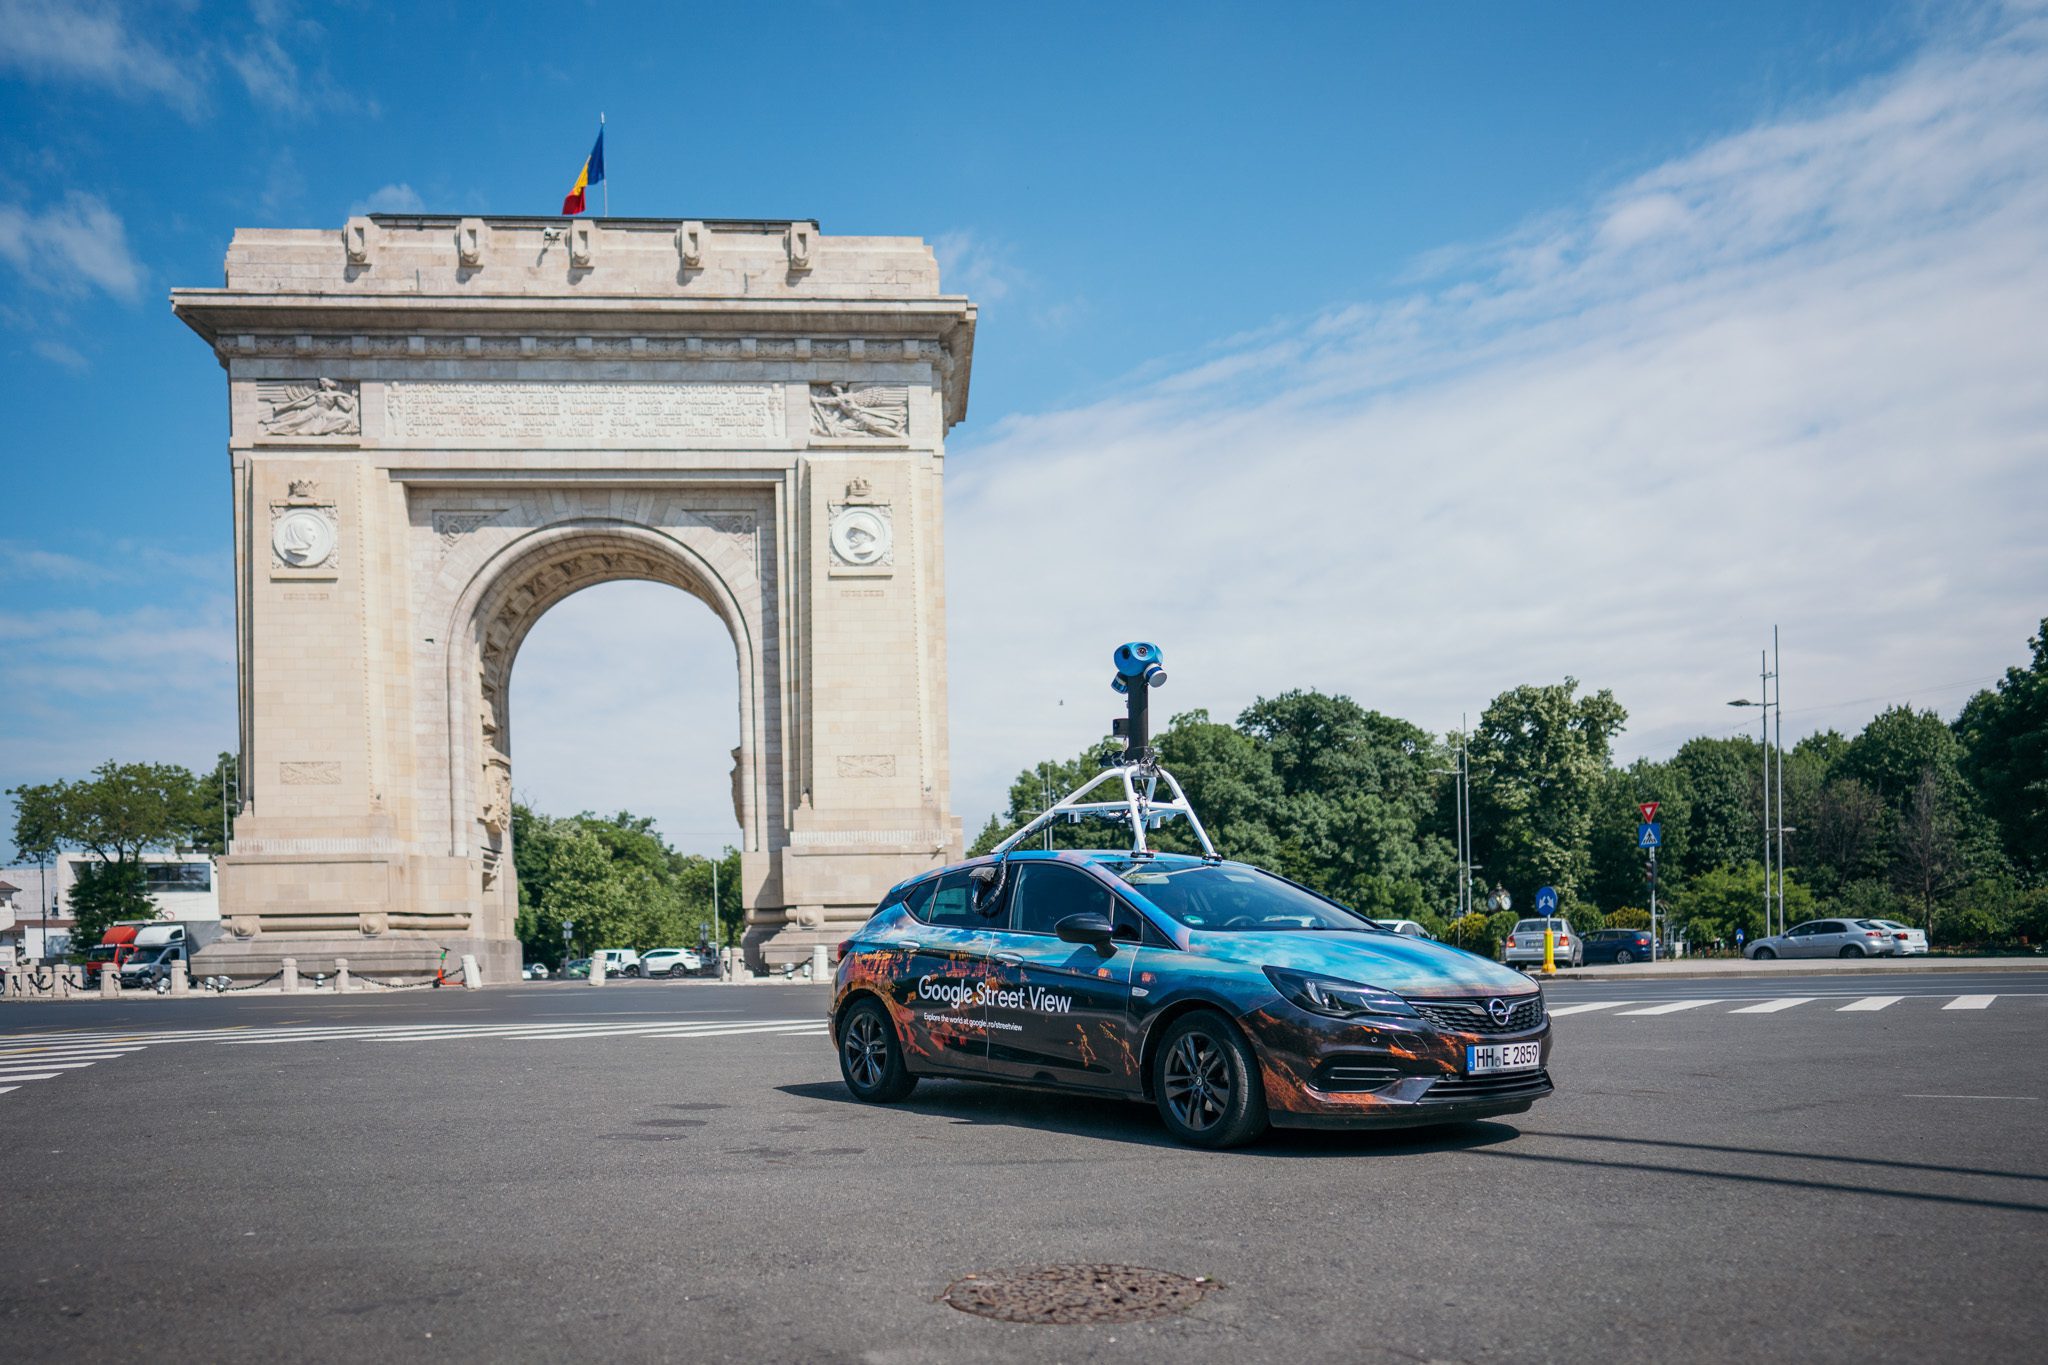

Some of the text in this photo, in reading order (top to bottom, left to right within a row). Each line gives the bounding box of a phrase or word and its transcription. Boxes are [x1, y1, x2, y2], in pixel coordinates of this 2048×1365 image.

[918, 975, 1072, 1014] Google Street View
[923, 1012, 941, 1022] Explore
[941, 1014, 950, 1022] the
[949, 1015, 963, 1024] world
[1476, 1045, 1538, 1067] HH E 2859
